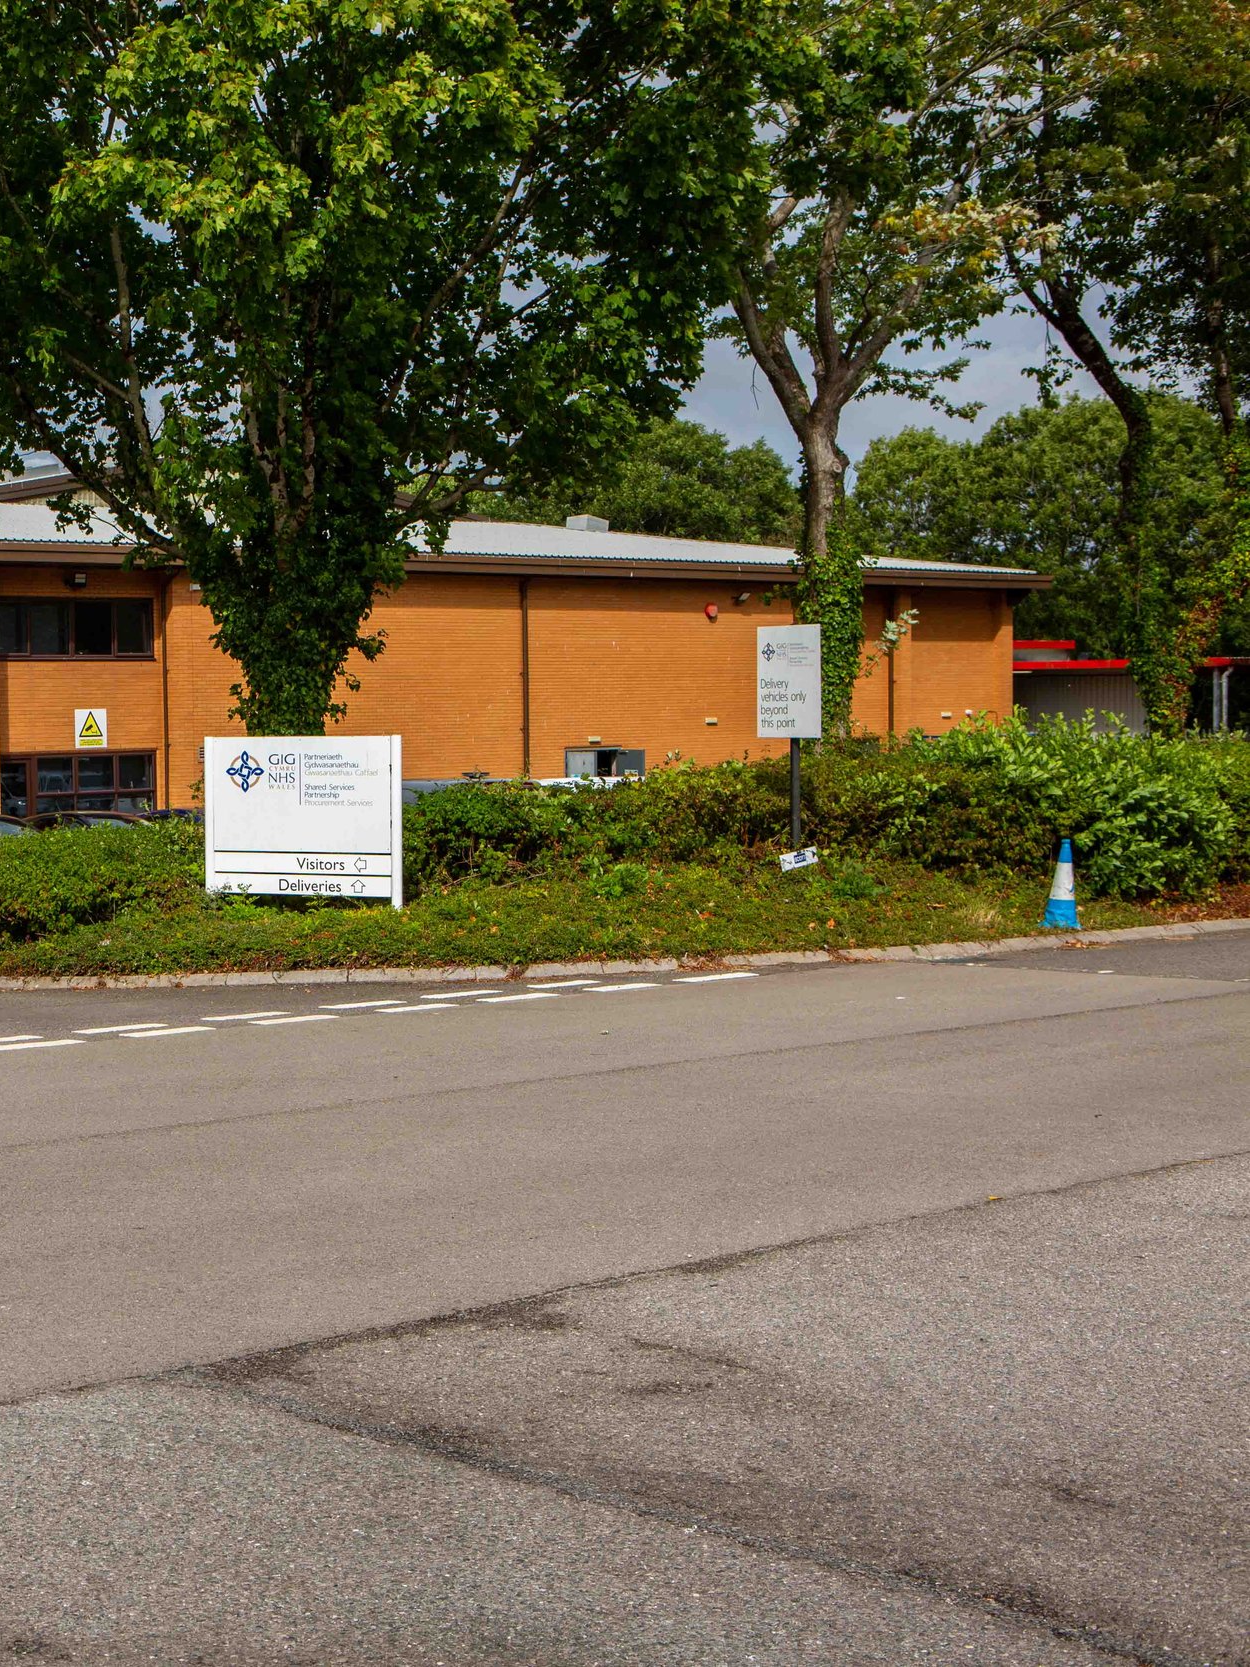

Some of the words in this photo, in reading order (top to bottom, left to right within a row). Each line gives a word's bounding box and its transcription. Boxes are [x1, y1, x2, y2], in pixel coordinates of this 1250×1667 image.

[760, 678, 789, 691] Delivery
[761, 691, 788, 702] vehicles
[790, 691, 807, 704] only
[761, 704, 788, 717] beyond
[761, 717, 774, 728] this
[776, 718, 796, 731] point
[268, 753, 296, 765] GIG
[268, 772, 296, 783] NHS
[296, 857, 345, 871] Visitors
[278, 878, 342, 893] Deliveries
